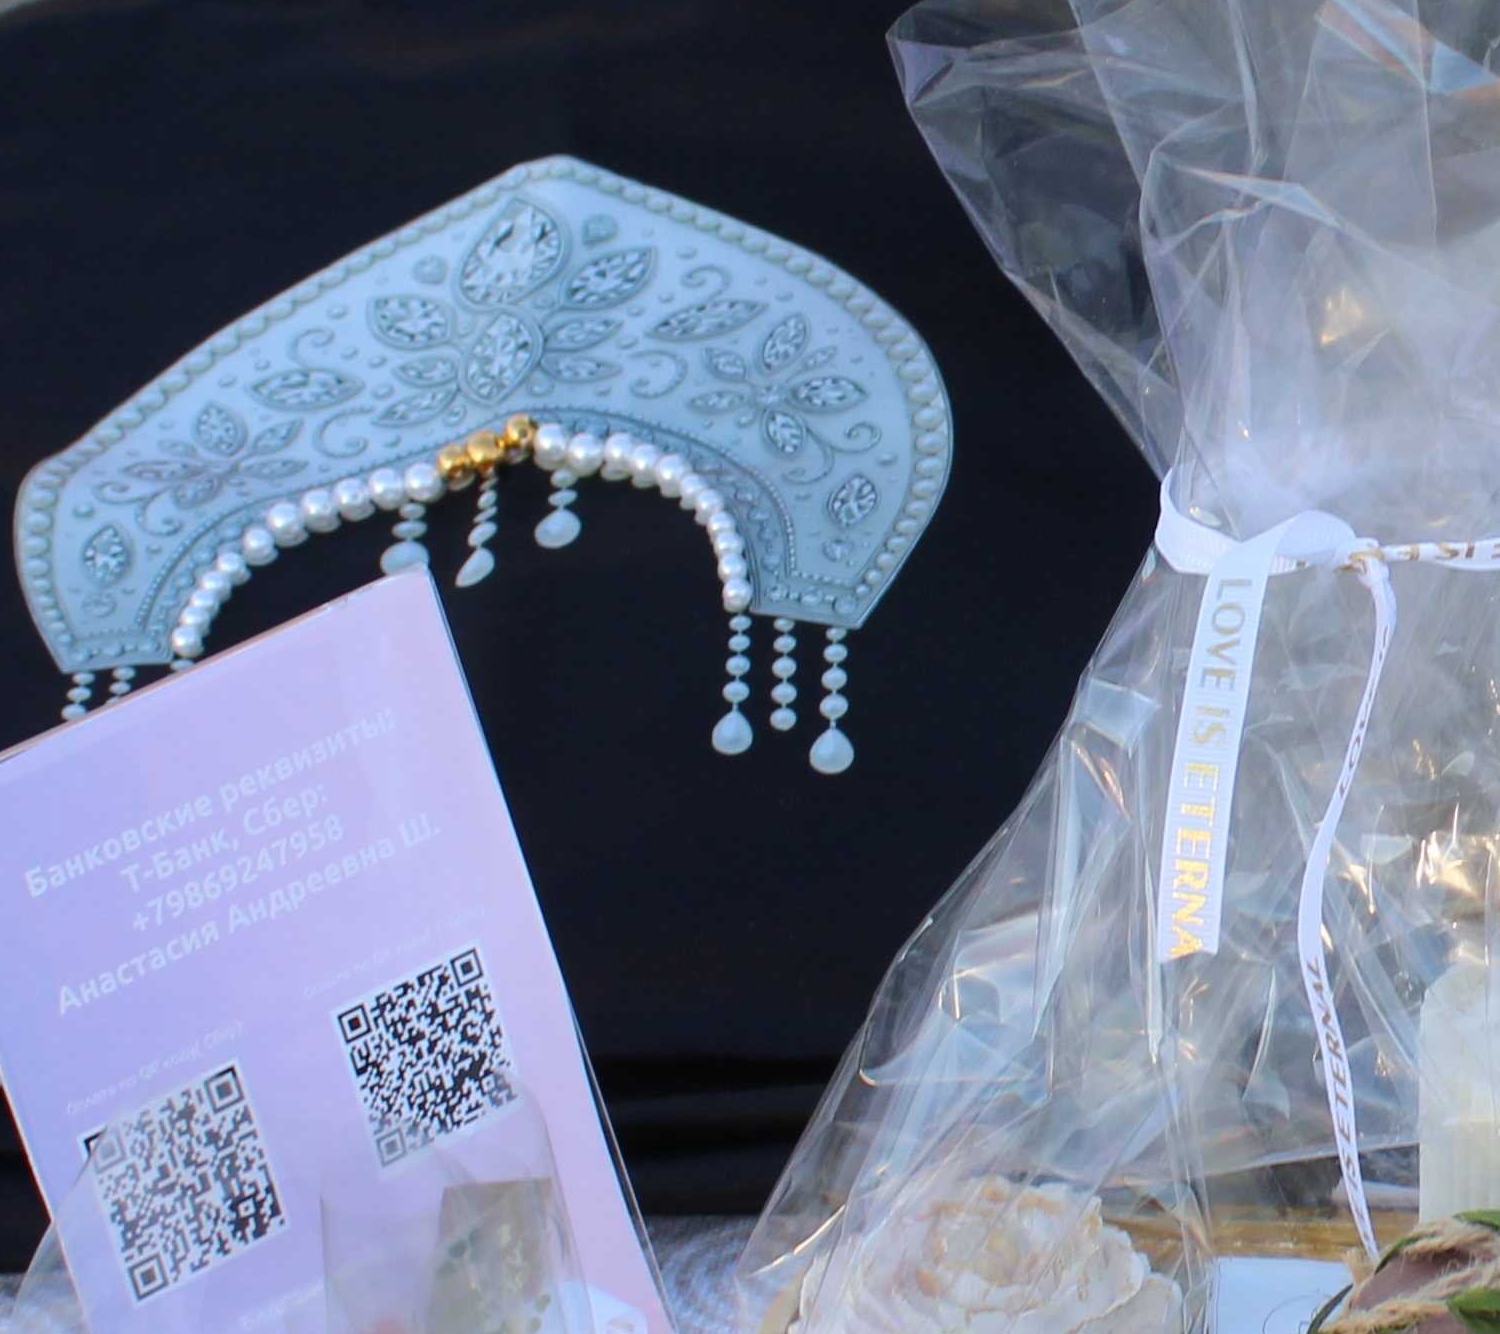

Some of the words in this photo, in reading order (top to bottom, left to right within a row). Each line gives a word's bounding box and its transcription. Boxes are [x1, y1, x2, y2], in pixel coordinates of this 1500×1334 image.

[1201, 577, 1253, 692] LOVE
[1191, 705, 1230, 749] IS
[23, 795, 213, 898] Банковские
[219, 708, 397, 813] реквизиты:
[120, 827, 240, 895] Т-Банк,
[243, 782, 329, 837] Сбер:
[58, 920, 220, 1017] Анастасия
[228, 835, 396, 934] Андреевна
[399, 812, 441, 849] Ш.
[132, 814, 345, 932] +79869247958
